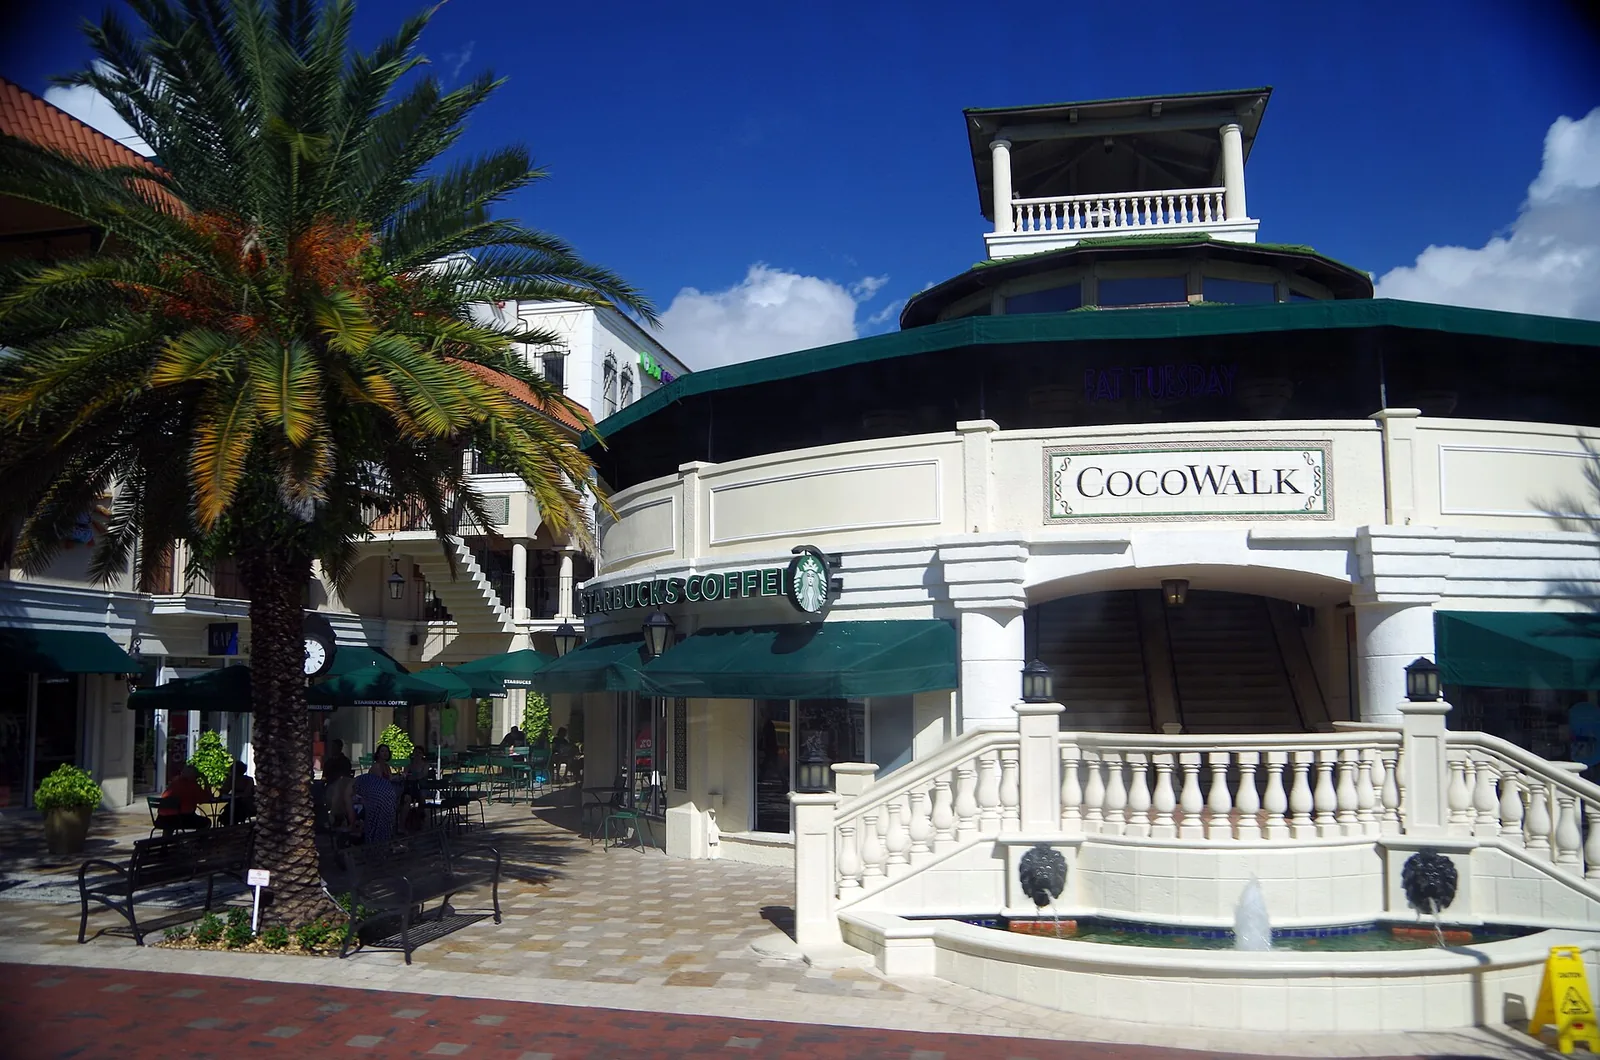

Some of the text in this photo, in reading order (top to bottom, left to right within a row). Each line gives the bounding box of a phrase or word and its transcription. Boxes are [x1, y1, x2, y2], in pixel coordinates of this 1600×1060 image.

[1084, 362, 1238, 402] FAT TUESDAY
[579, 578, 680, 616] STARBUCKS
[212, 631, 232, 648] GAP
